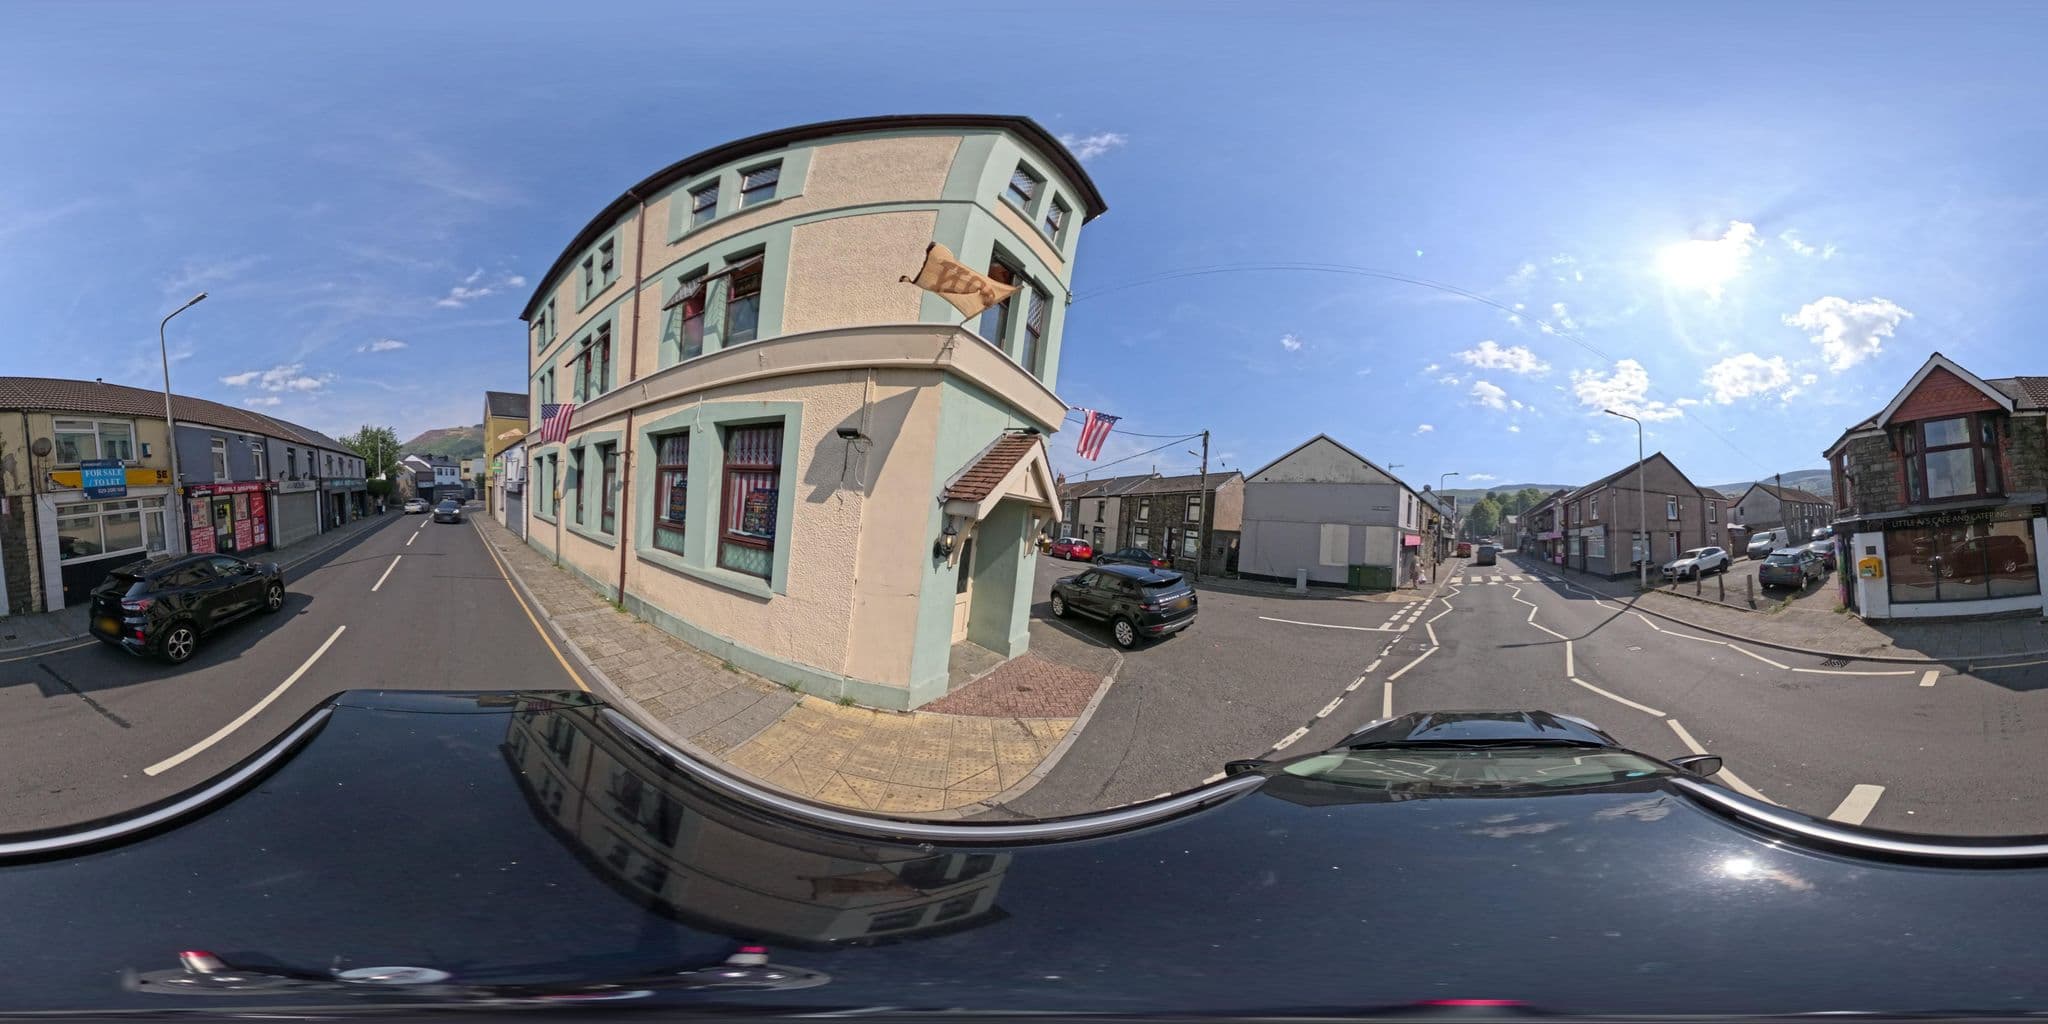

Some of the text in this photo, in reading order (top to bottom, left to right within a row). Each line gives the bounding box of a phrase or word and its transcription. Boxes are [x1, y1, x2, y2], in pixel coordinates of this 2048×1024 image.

[85, 468, 122, 478] FOR SALE
[106, 478, 121, 486] LET
[1892, 520, 1914, 528] LITTLE
